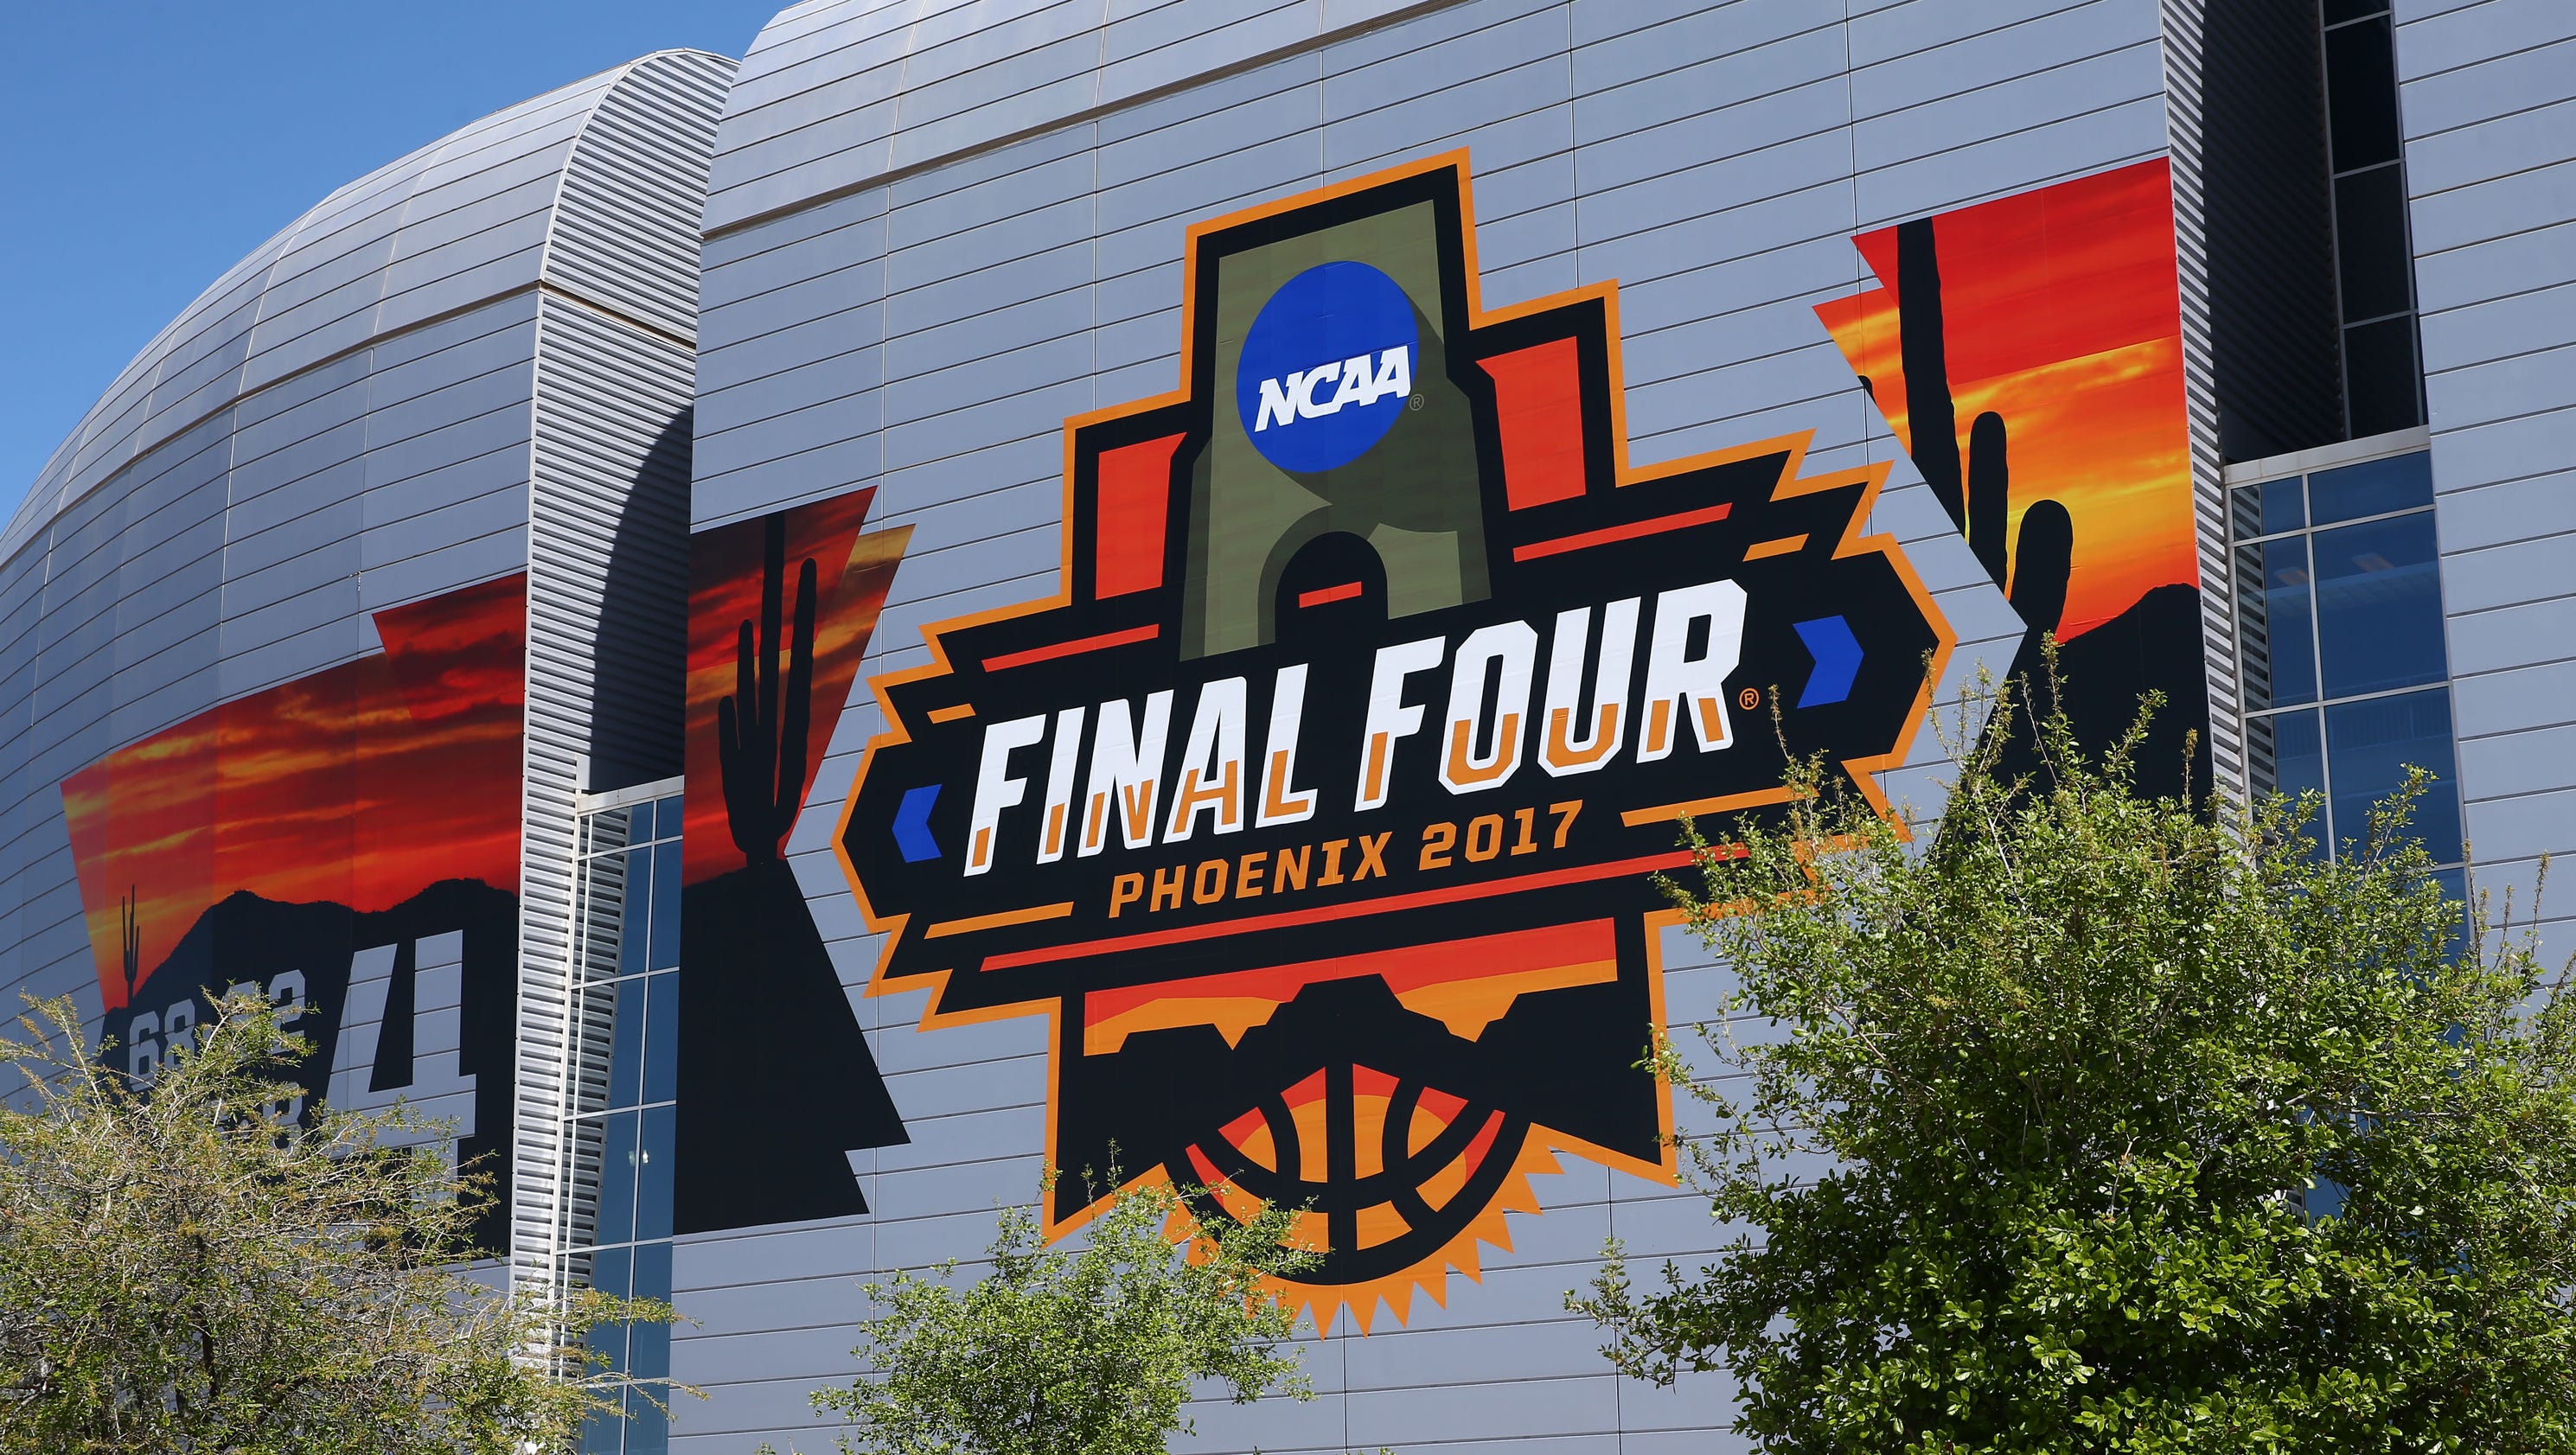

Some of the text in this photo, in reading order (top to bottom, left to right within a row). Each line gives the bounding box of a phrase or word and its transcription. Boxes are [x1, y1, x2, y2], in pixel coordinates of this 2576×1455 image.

[1254, 344, 1411, 432] NCAA
[963, 578, 1748, 877] FINAL FOUR
[1108, 799, 1583, 919] PHOENIX 2017
[316, 929, 476, 1221] 4
